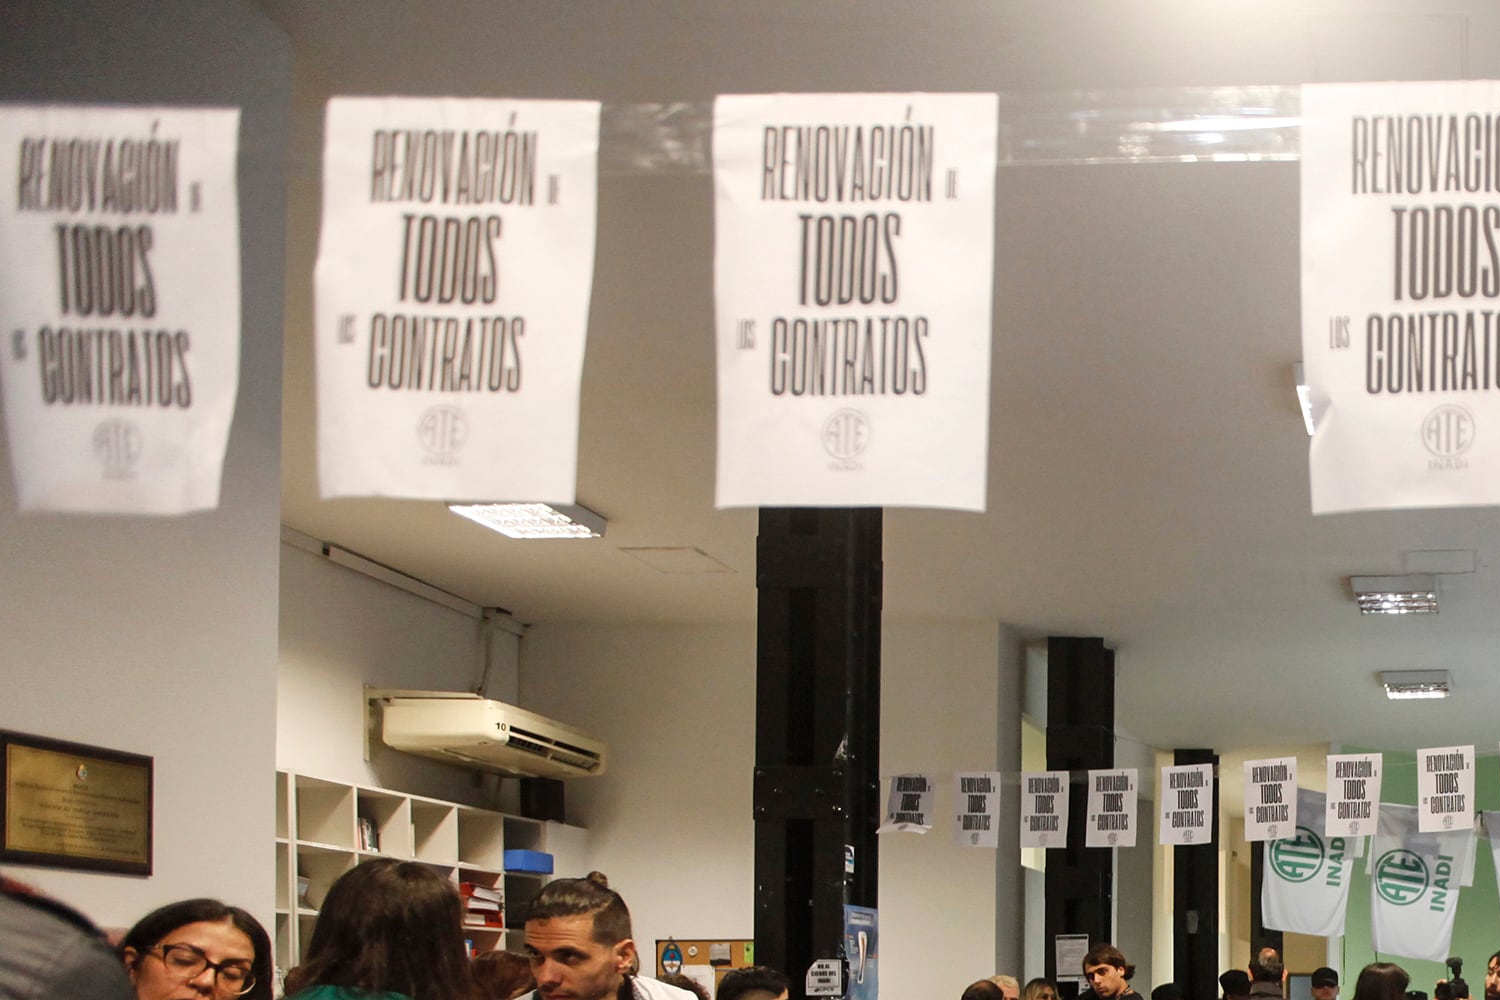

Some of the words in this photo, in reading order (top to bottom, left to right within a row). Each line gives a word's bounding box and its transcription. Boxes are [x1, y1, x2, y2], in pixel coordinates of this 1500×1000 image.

[17, 120, 180, 213] RENOVACIÓN
[370, 111, 538, 205] RENOVACIÓN
[761, 105, 934, 201] RENOVACIÓN
[55, 223, 157, 319] TODOS
[399, 213, 502, 305] TODOS
[798, 212, 901, 306] TODOS
[1392, 203, 1500, 301] TODOS
[367, 313, 525, 392] CONTRATOS
[771, 317, 928, 396] CONTRATOS
[1329, 315, 1350, 349] LOS
[38, 326, 192, 409] CONTRATOS
[825, 411, 866, 453] ATE
[1426, 409, 1470, 454] ATE
[495, 722, 507, 731] 10
[1335, 757, 1372, 778] RENOVACIÓN
[1426, 750, 1464, 772] RENOVACIÓN
[1435, 773, 1459, 794] TODOS
[1338, 801, 1371, 819] CONTRATOS
[1343, 780, 1366, 800] TODOS
[1430, 794, 1465, 814] CONTRATOS
[1326, 837, 1345, 886] INAD
[1378, 853, 1427, 903] ATE
[1430, 855, 1454, 912] INADI
